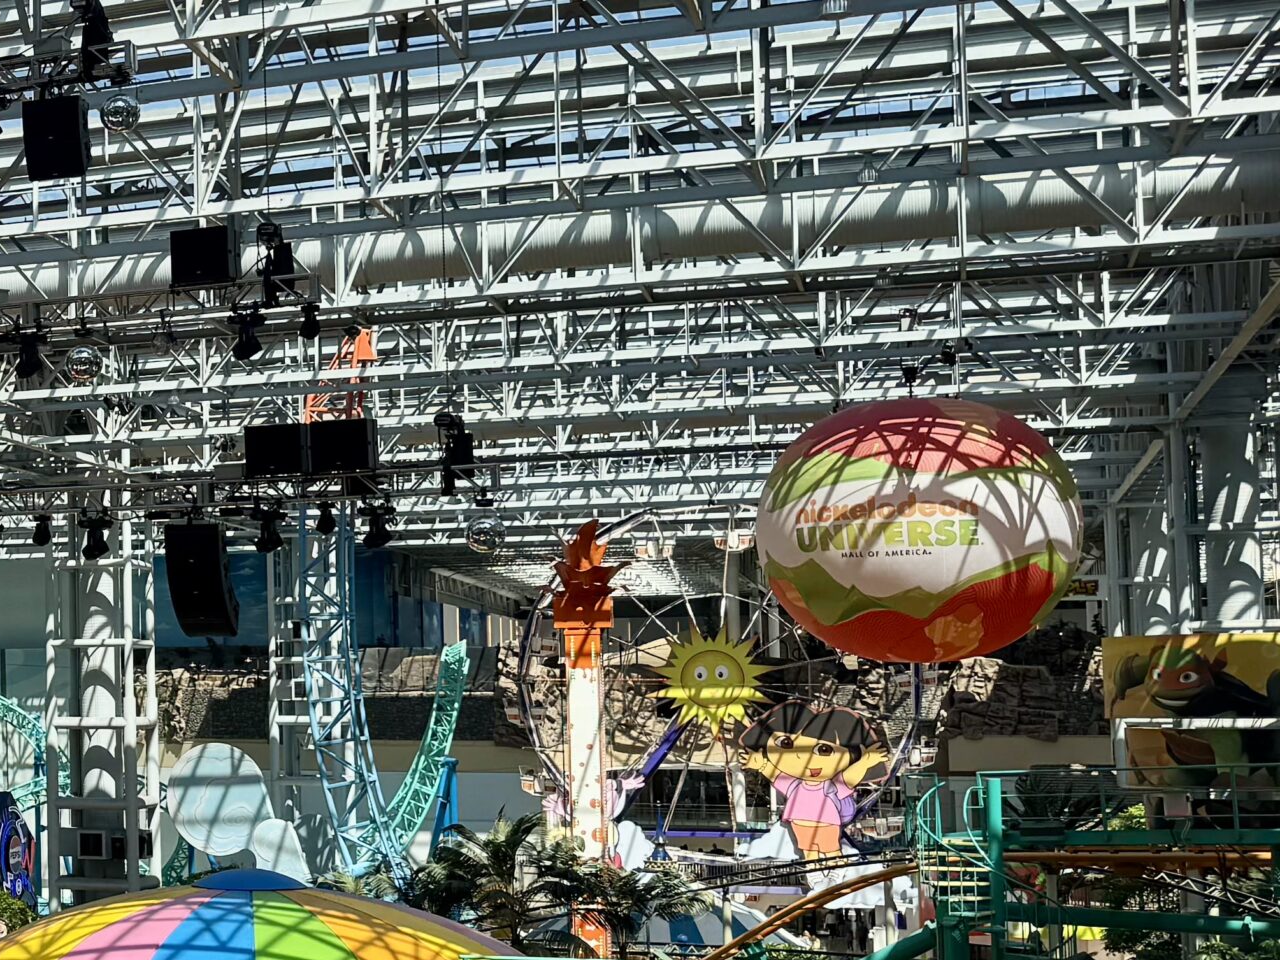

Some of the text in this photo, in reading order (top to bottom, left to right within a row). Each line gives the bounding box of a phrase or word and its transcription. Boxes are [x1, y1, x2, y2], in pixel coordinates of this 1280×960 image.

[796, 491, 979, 525] nickelodeon
[796, 519, 979, 553] UNIVERSE
[841, 551, 864, 559] MALL
[868, 550, 879, 558] OF
